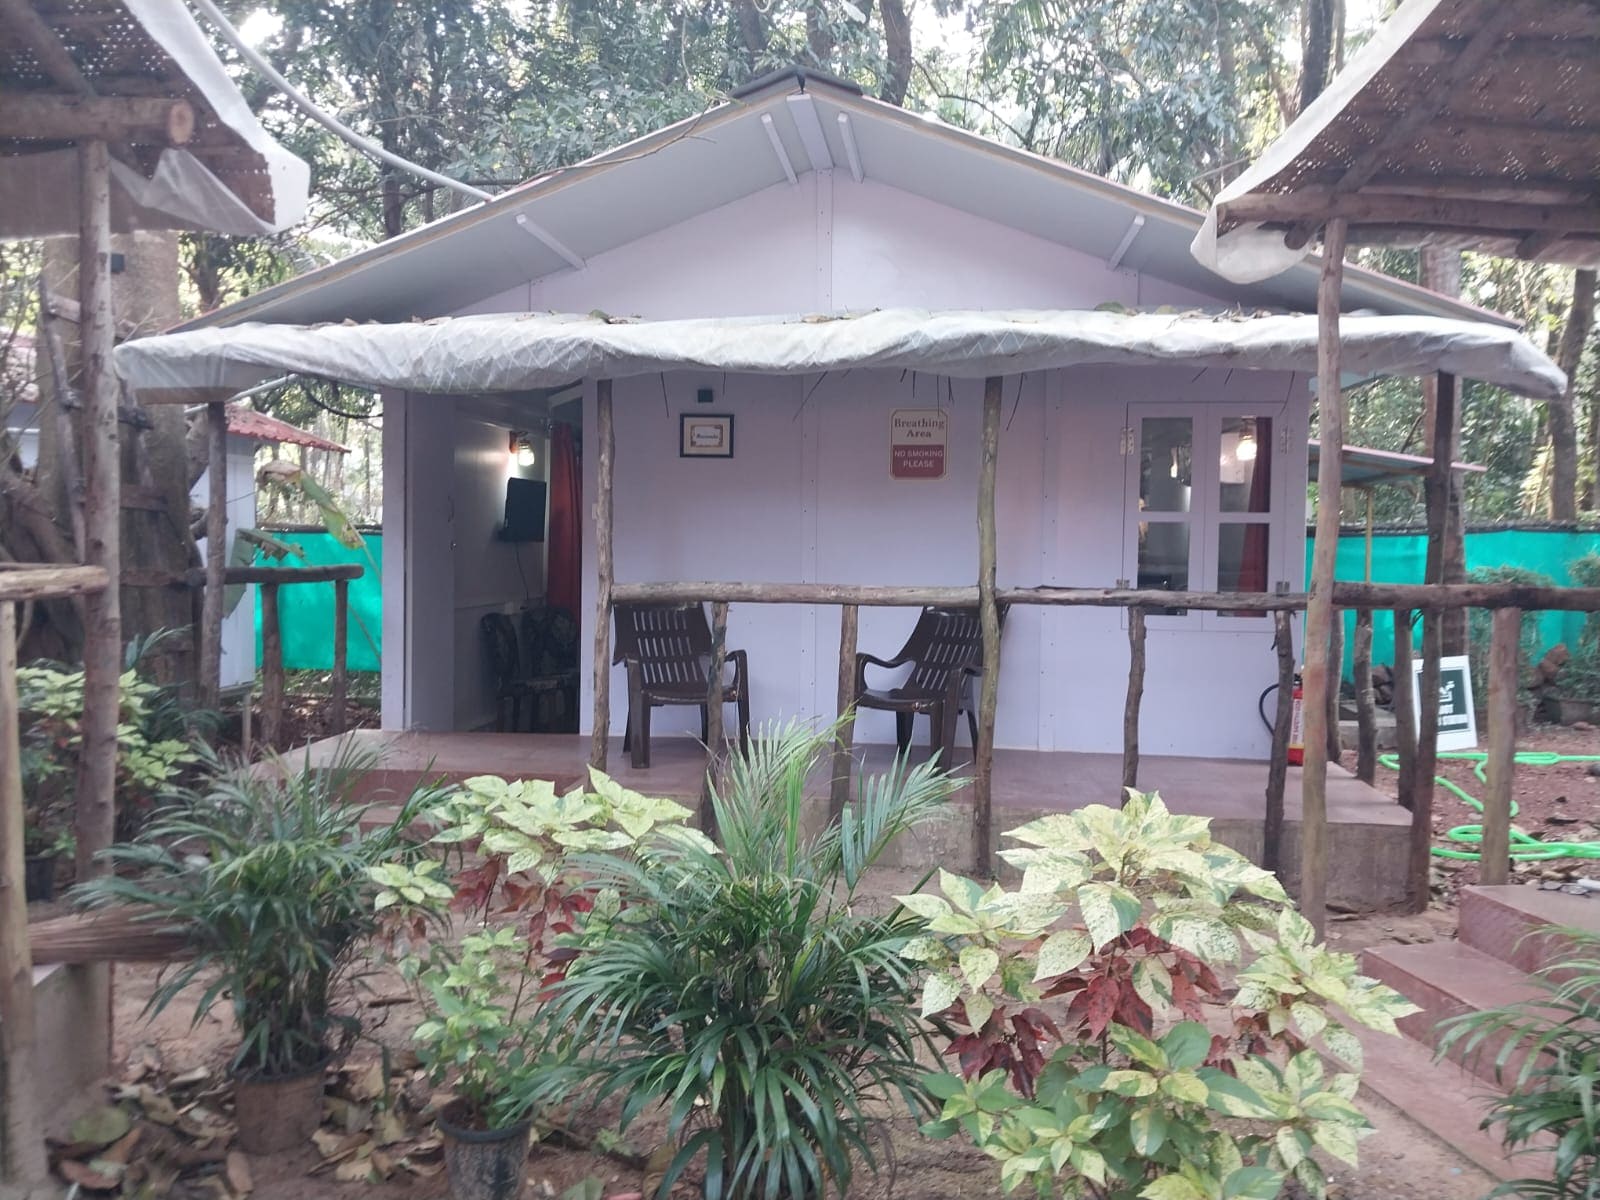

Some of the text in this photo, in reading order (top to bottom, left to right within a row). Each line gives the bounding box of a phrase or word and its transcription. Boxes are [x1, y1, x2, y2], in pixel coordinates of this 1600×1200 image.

[895, 418, 944, 430] Breathing
[906, 430, 932, 438] Area
[894, 449, 943, 457] NO SMOKING
[903, 459, 934, 468] PLEASE
